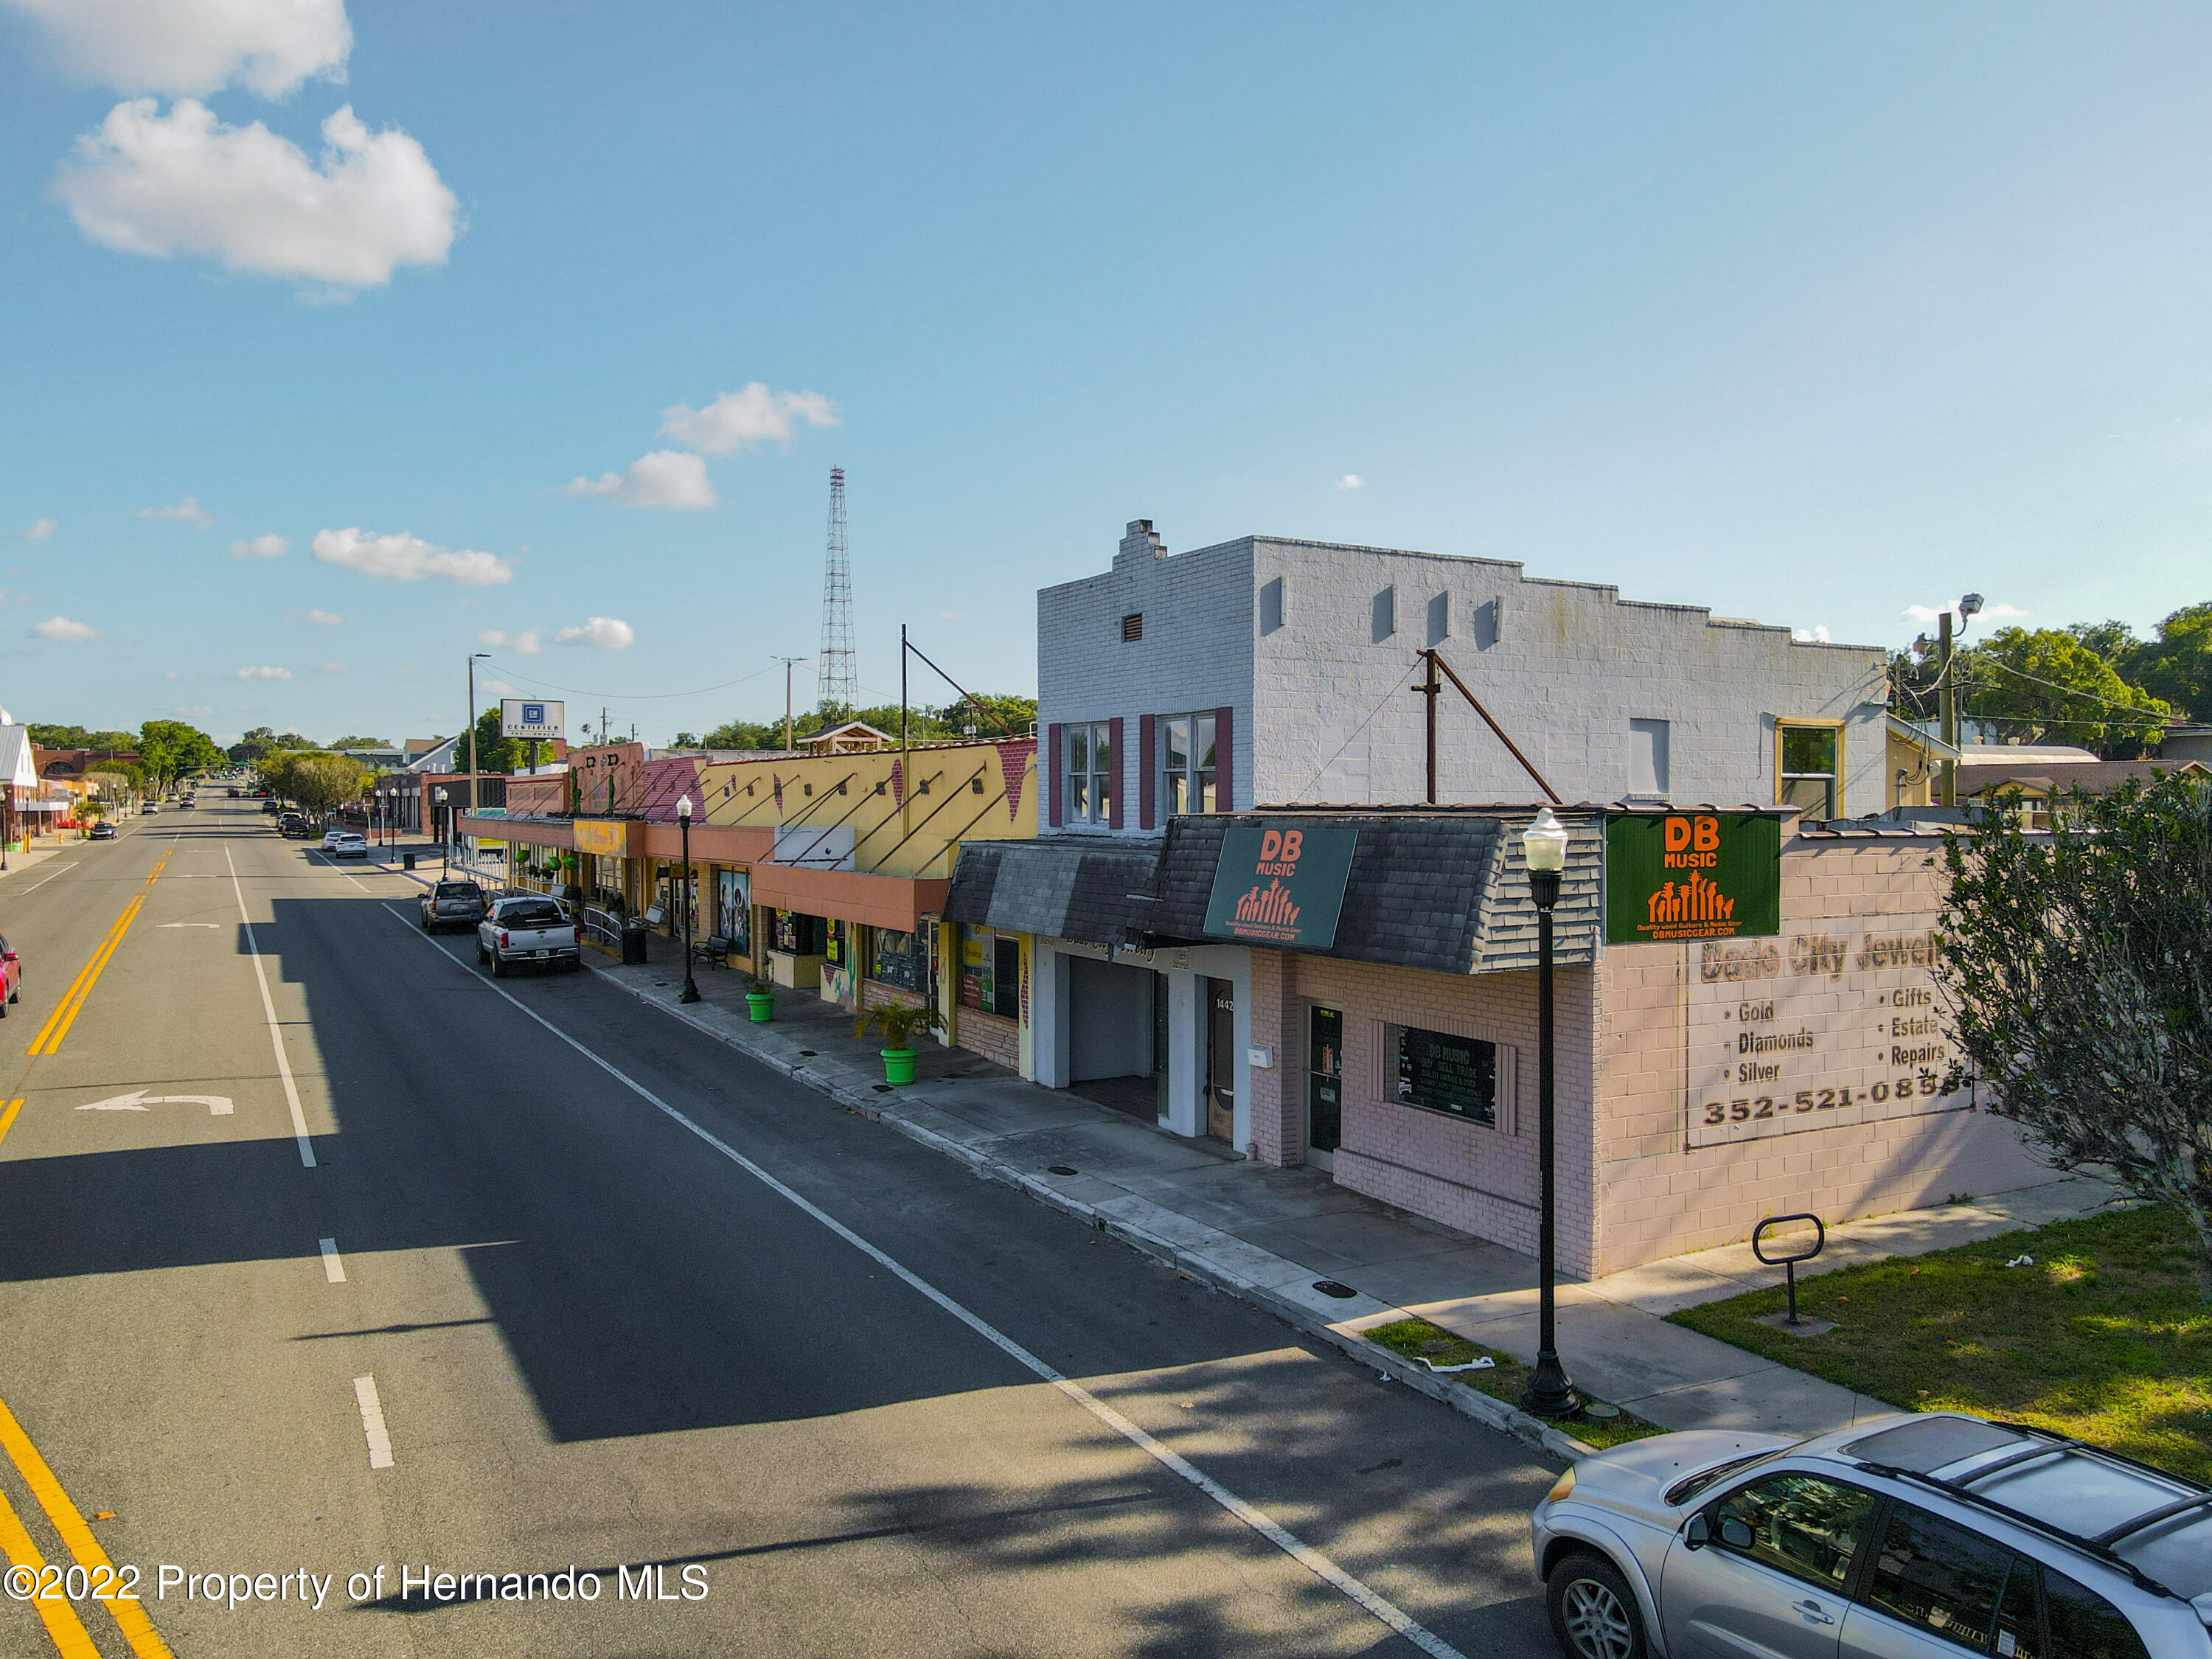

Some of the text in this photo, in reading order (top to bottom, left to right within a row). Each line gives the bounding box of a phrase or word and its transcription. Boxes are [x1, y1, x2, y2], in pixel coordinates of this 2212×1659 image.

[529, 710, 538, 718] GM
[1665, 815, 1720, 852] DB
[1260, 830, 1304, 862] DB
[1256, 862, 1295, 877] MUSIC
[1664, 852, 1717, 869] MUSIC
[1234, 928, 1295, 940] DBMUSICGEAR.COM
[1652, 927, 1735, 939] DBMUSICGEAR.COM
[1701, 937, 1781, 984] Dade
[1789, 932, 1848, 984] City
[1217, 998, 1234, 1011] 1442
[1892, 987, 1932, 1008] Gifts
[1739, 1000, 1775, 1023] Gold
[1891, 1015, 1938, 1037] Estate
[1739, 1026, 1814, 1054] Diamonds
[1442, 1046, 1470, 1065] MUSIC
[1891, 1042, 1945, 1070] Repairs
[1437, 1060, 1454, 1074] SELL
[1457, 1065, 1478, 1079] TRADE
[1739, 1062, 1780, 1083] Silver
